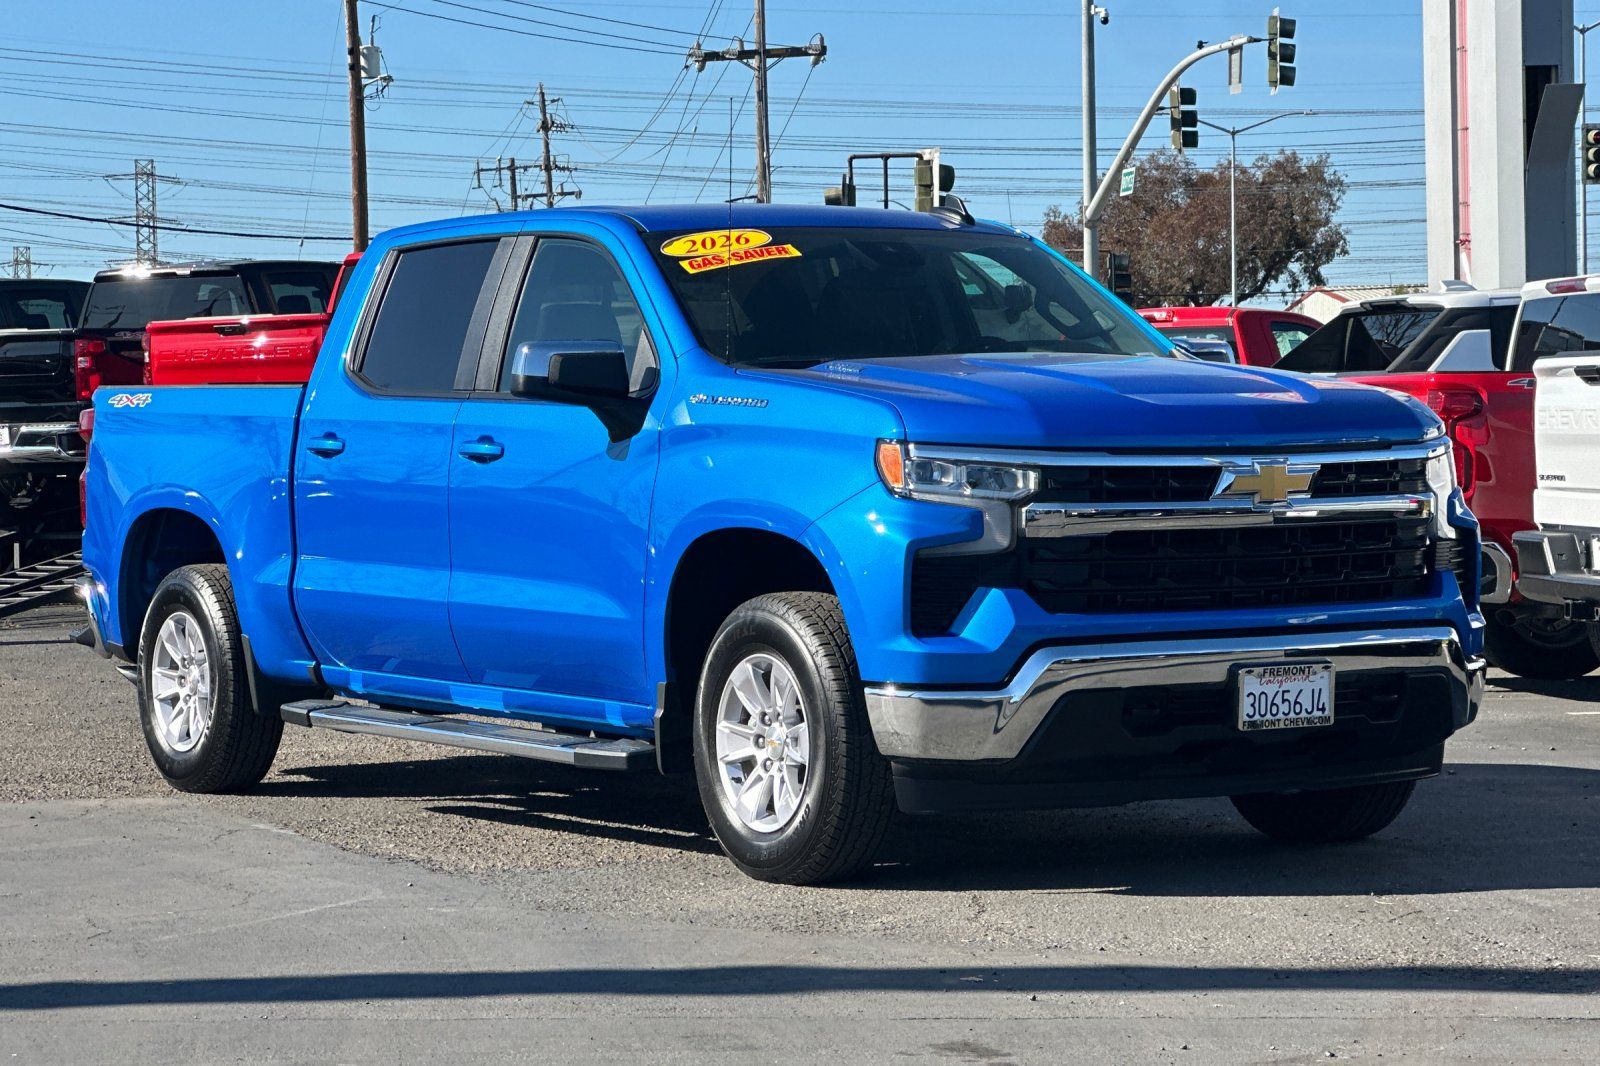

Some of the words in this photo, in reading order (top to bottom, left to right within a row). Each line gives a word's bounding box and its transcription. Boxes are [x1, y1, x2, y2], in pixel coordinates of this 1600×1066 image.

[683, 232, 750, 253] 2026
[688, 255, 725, 270] GAS
[731, 246, 788, 261] SAVER
[1262, 666, 1313, 677] FREMONT
[1246, 688, 1326, 719] 30656J4
[1242, 719, 1281, 730] FREMONT
